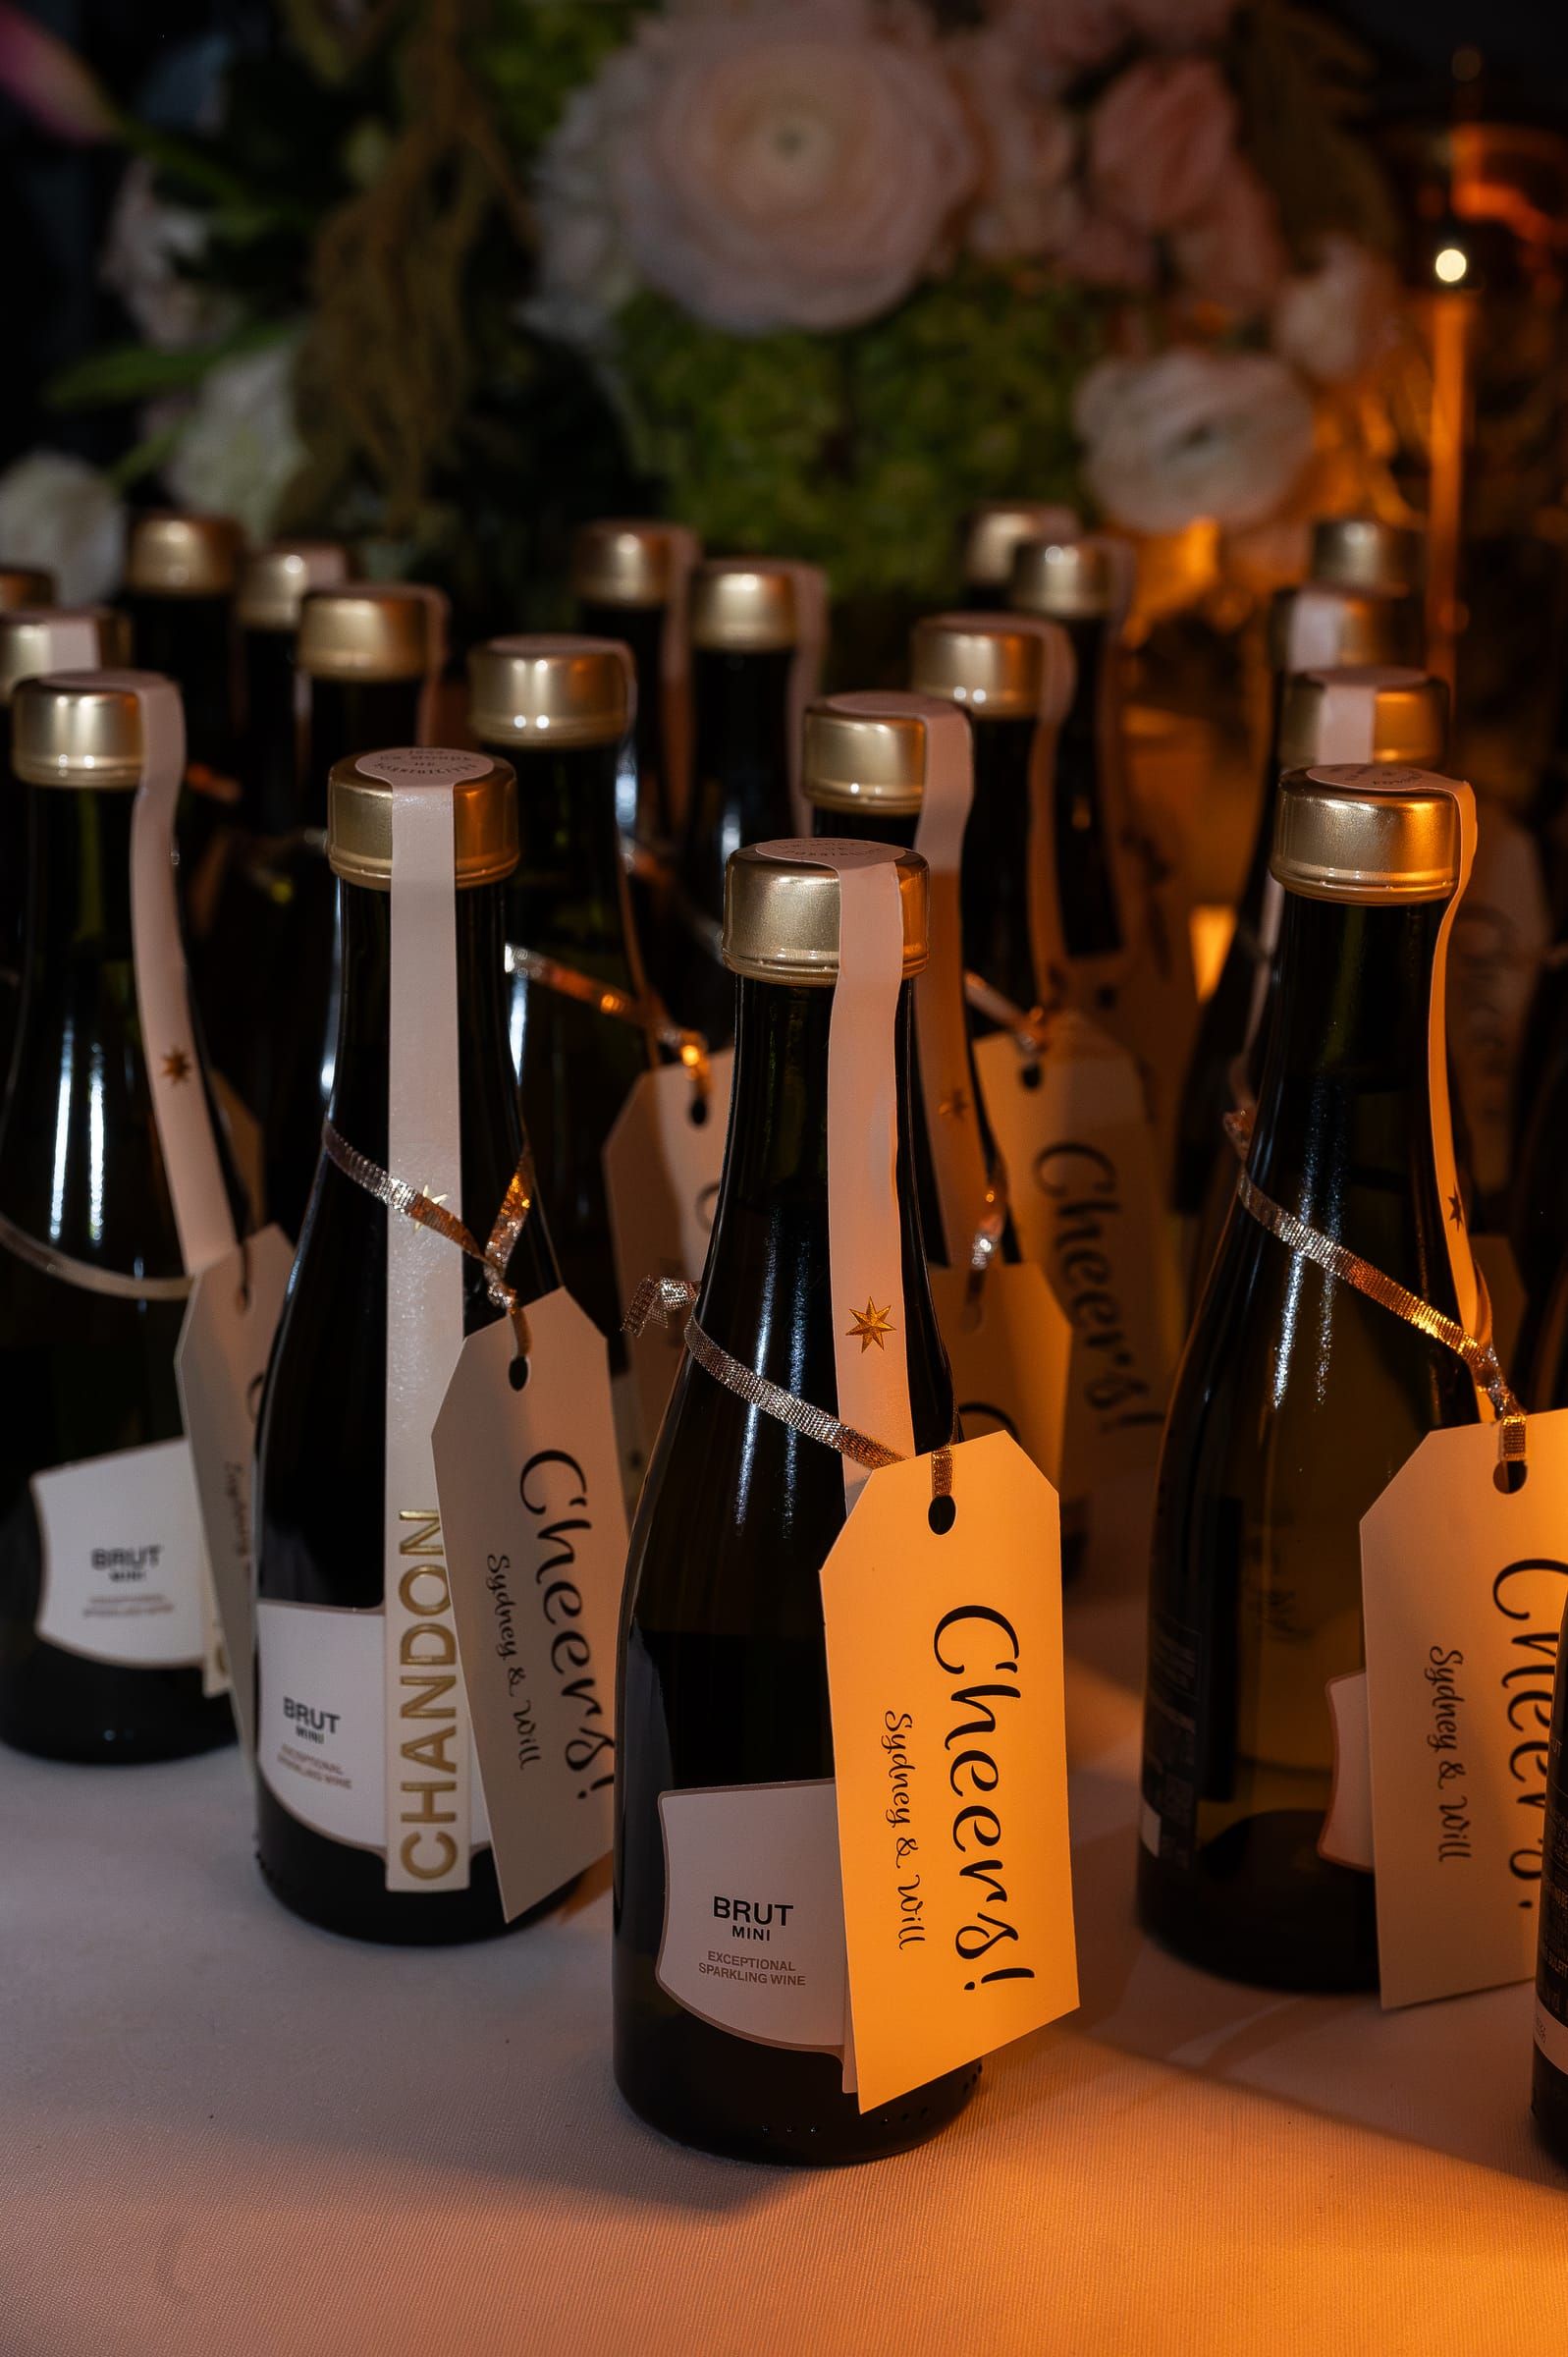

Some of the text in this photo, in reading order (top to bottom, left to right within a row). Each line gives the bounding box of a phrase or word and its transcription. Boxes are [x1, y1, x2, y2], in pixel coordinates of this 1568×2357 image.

[1034, 1141, 1165, 1434] Cheers!
[283, 1696, 341, 1734] BRUT
[398, 1509, 459, 1881] CHANDON
[486, 1554, 541, 1771] Sydney & Will
[519, 1449, 615, 1800] Cheers!
[1492, 1558, 1568, 1909] Chee
[881, 1709, 926, 1951] Sydney & Will
[933, 1605, 1036, 1991] Cheers!
[1424, 1645, 1472, 1863] Sydney & Will
[698, 1962, 807, 1987] SPARKLING WINE
[707, 1949, 796, 1972] EXCEPTIONAL
[713, 1895, 794, 1927] BRUT
[731, 1925, 771, 1942] MINI
